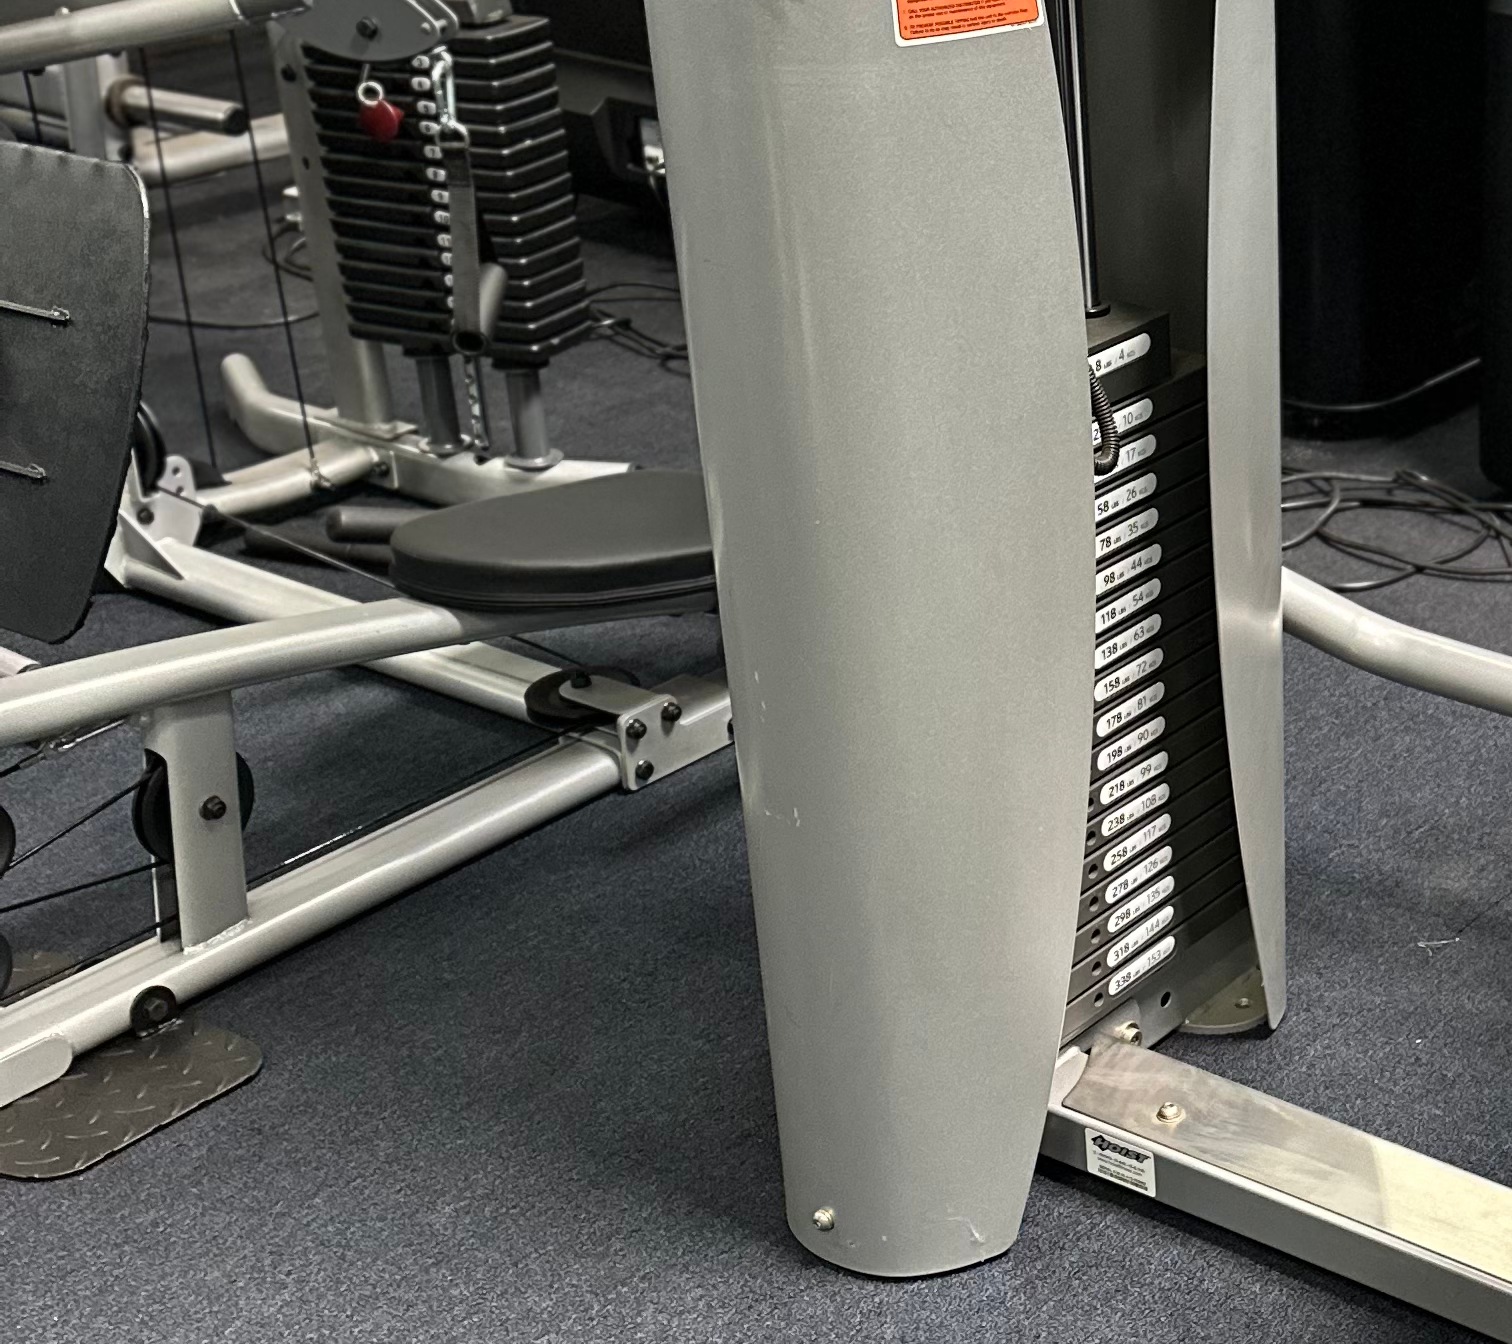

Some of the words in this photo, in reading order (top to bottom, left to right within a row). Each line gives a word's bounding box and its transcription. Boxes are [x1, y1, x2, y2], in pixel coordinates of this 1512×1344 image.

[1119, 348, 1125, 361] 4
[1122, 411, 1134, 425] 10
[1126, 447, 1136, 463] 17
[1097, 500, 1109, 516] 58
[1126, 486, 1137, 502] 26
[1100, 536, 1111, 551] 78
[1128, 521, 1139, 536] 35
[1103, 571, 1115, 587] 98
[1131, 558, 1142, 571] 44
[1101, 608, 1117, 625] 118
[1132, 591, 1144, 607] 54
[1101, 642, 1118, 660] 138
[1134, 626, 1145, 641] 63
[1103, 677, 1121, 695] 158
[1136, 660, 1147, 676] 72
[1106, 712, 1123, 730] 178
[1137, 696, 1147, 710] 81
[1106, 746, 1123, 764] 198
[1137, 728, 1149, 744] 90
[1108, 780, 1125, 798] 218
[1140, 764, 1152, 779] 99
[1107, 812, 1126, 832] 238
[1141, 794, 1157, 812] 108
[1110, 846, 1128, 866] 258
[1143, 824, 1157, 841] 117
[1112, 879, 1129, 898] 278
[1143, 859, 1159, 875] 126
[1114, 908, 1131, 928] 298
[1146, 887, 1161, 905] 135
[1113, 942, 1130, 962] 318
[1145, 918, 1160, 937] 144
[1114, 972, 1132, 991] 338
[1147, 949, 1161, 967] 153
[1094, 1137, 1151, 1163] HOIST
